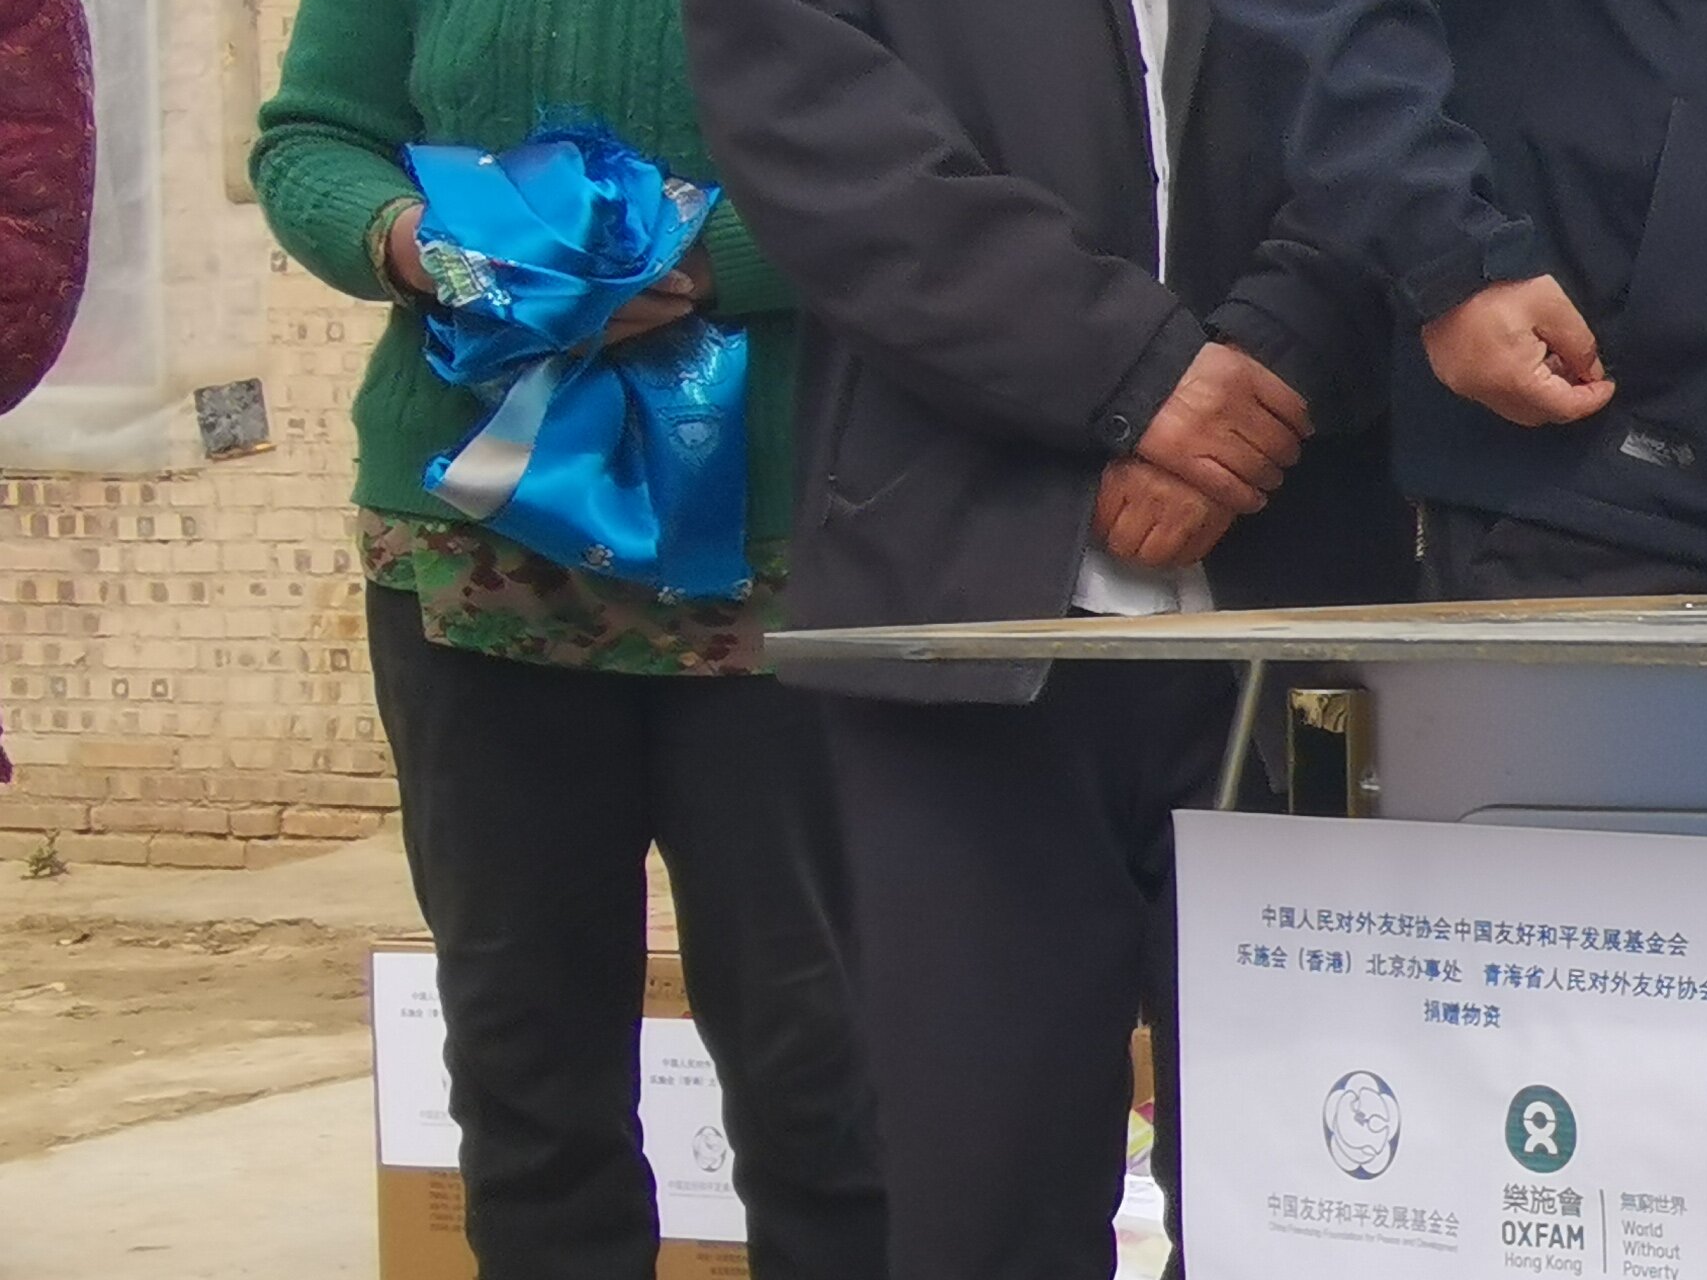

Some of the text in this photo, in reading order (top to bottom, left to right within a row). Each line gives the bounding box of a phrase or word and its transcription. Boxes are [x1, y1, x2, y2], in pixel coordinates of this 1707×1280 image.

[1260, 904, 1689, 957] 中国人民对外友好协会中国友好和平发展基金会
[1423, 998, 1502, 1029] 捐赠物资
[1267, 1192, 1461, 1239] 中国友好和平发展基金会
[1501, 1182, 1585, 1218] 樂施會
[1501, 1219, 1585, 1251] OXFAM
[1621, 1220, 1664, 1239] World
[1504, 1251, 1583, 1277] Hong Kong
[1622, 1239, 1681, 1261] Without
